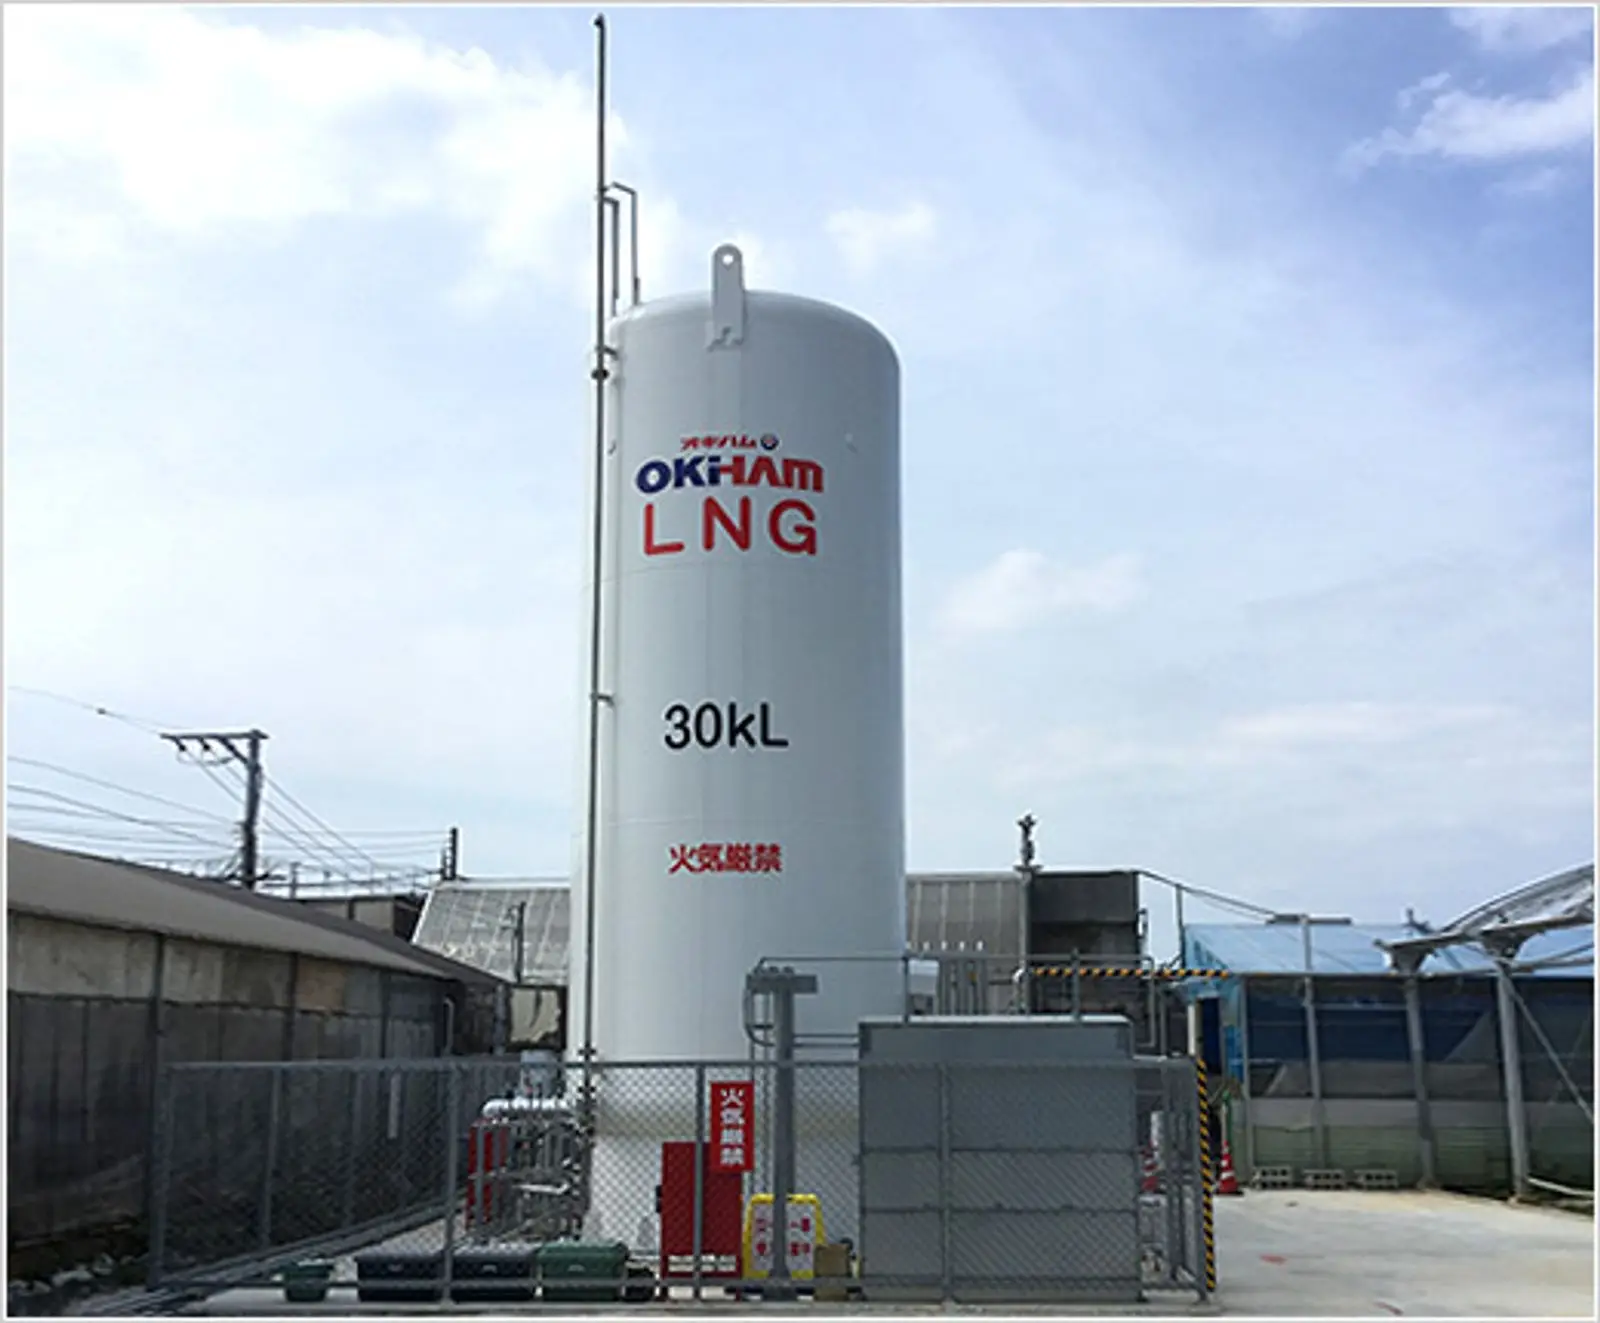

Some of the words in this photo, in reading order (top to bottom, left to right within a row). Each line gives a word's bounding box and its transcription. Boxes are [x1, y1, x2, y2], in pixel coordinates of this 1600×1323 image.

[664, 701, 789, 749] 30kL
[668, 843, 782, 874] 火気厳禁
